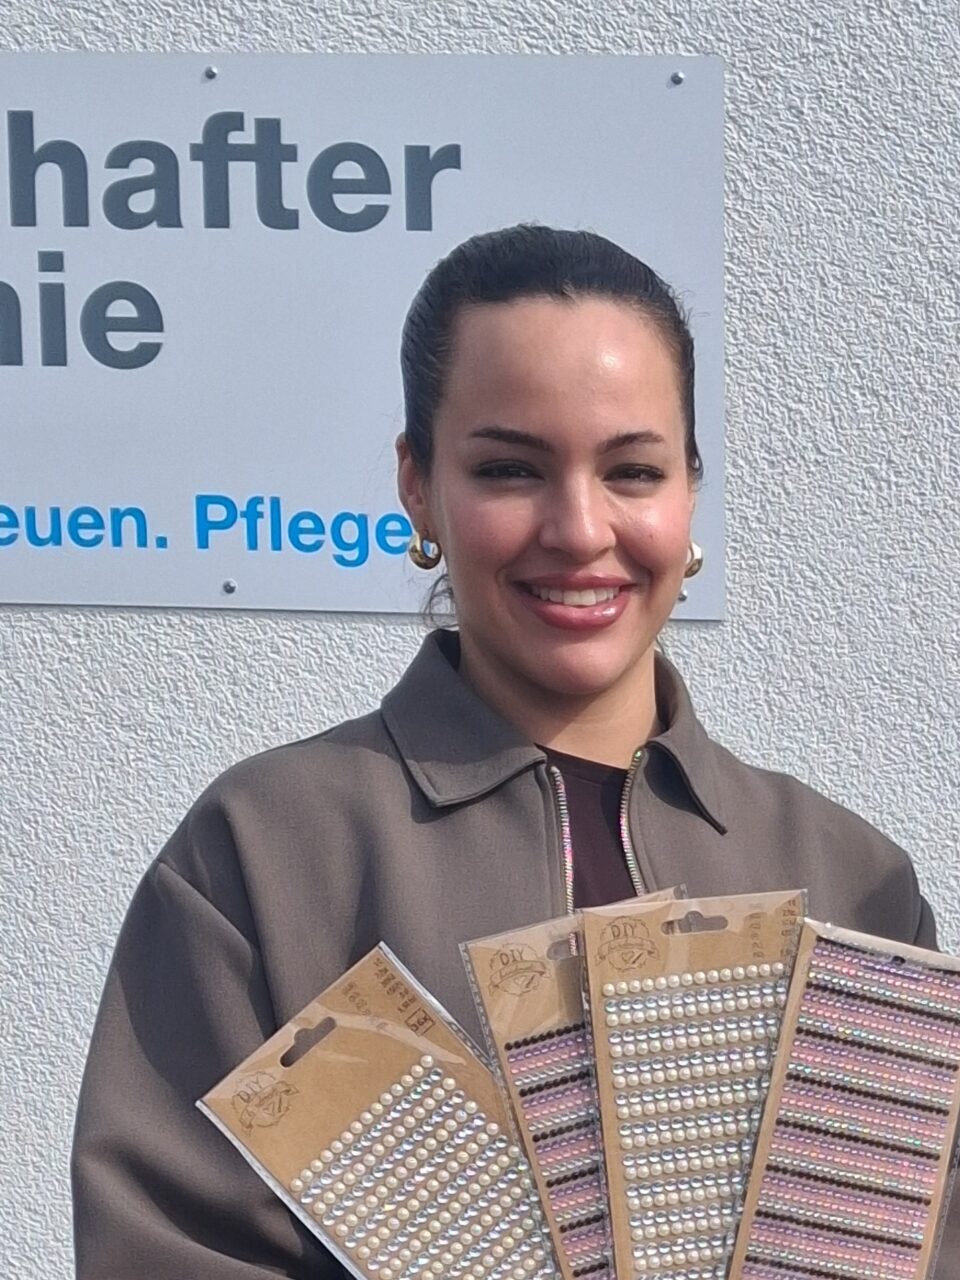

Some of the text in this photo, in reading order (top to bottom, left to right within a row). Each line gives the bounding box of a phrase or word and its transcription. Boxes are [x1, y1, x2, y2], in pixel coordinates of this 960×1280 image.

[8, 110, 462, 232] hafter
[0, 250, 165, 370] ie
[194, 494, 430, 568] Pflege
